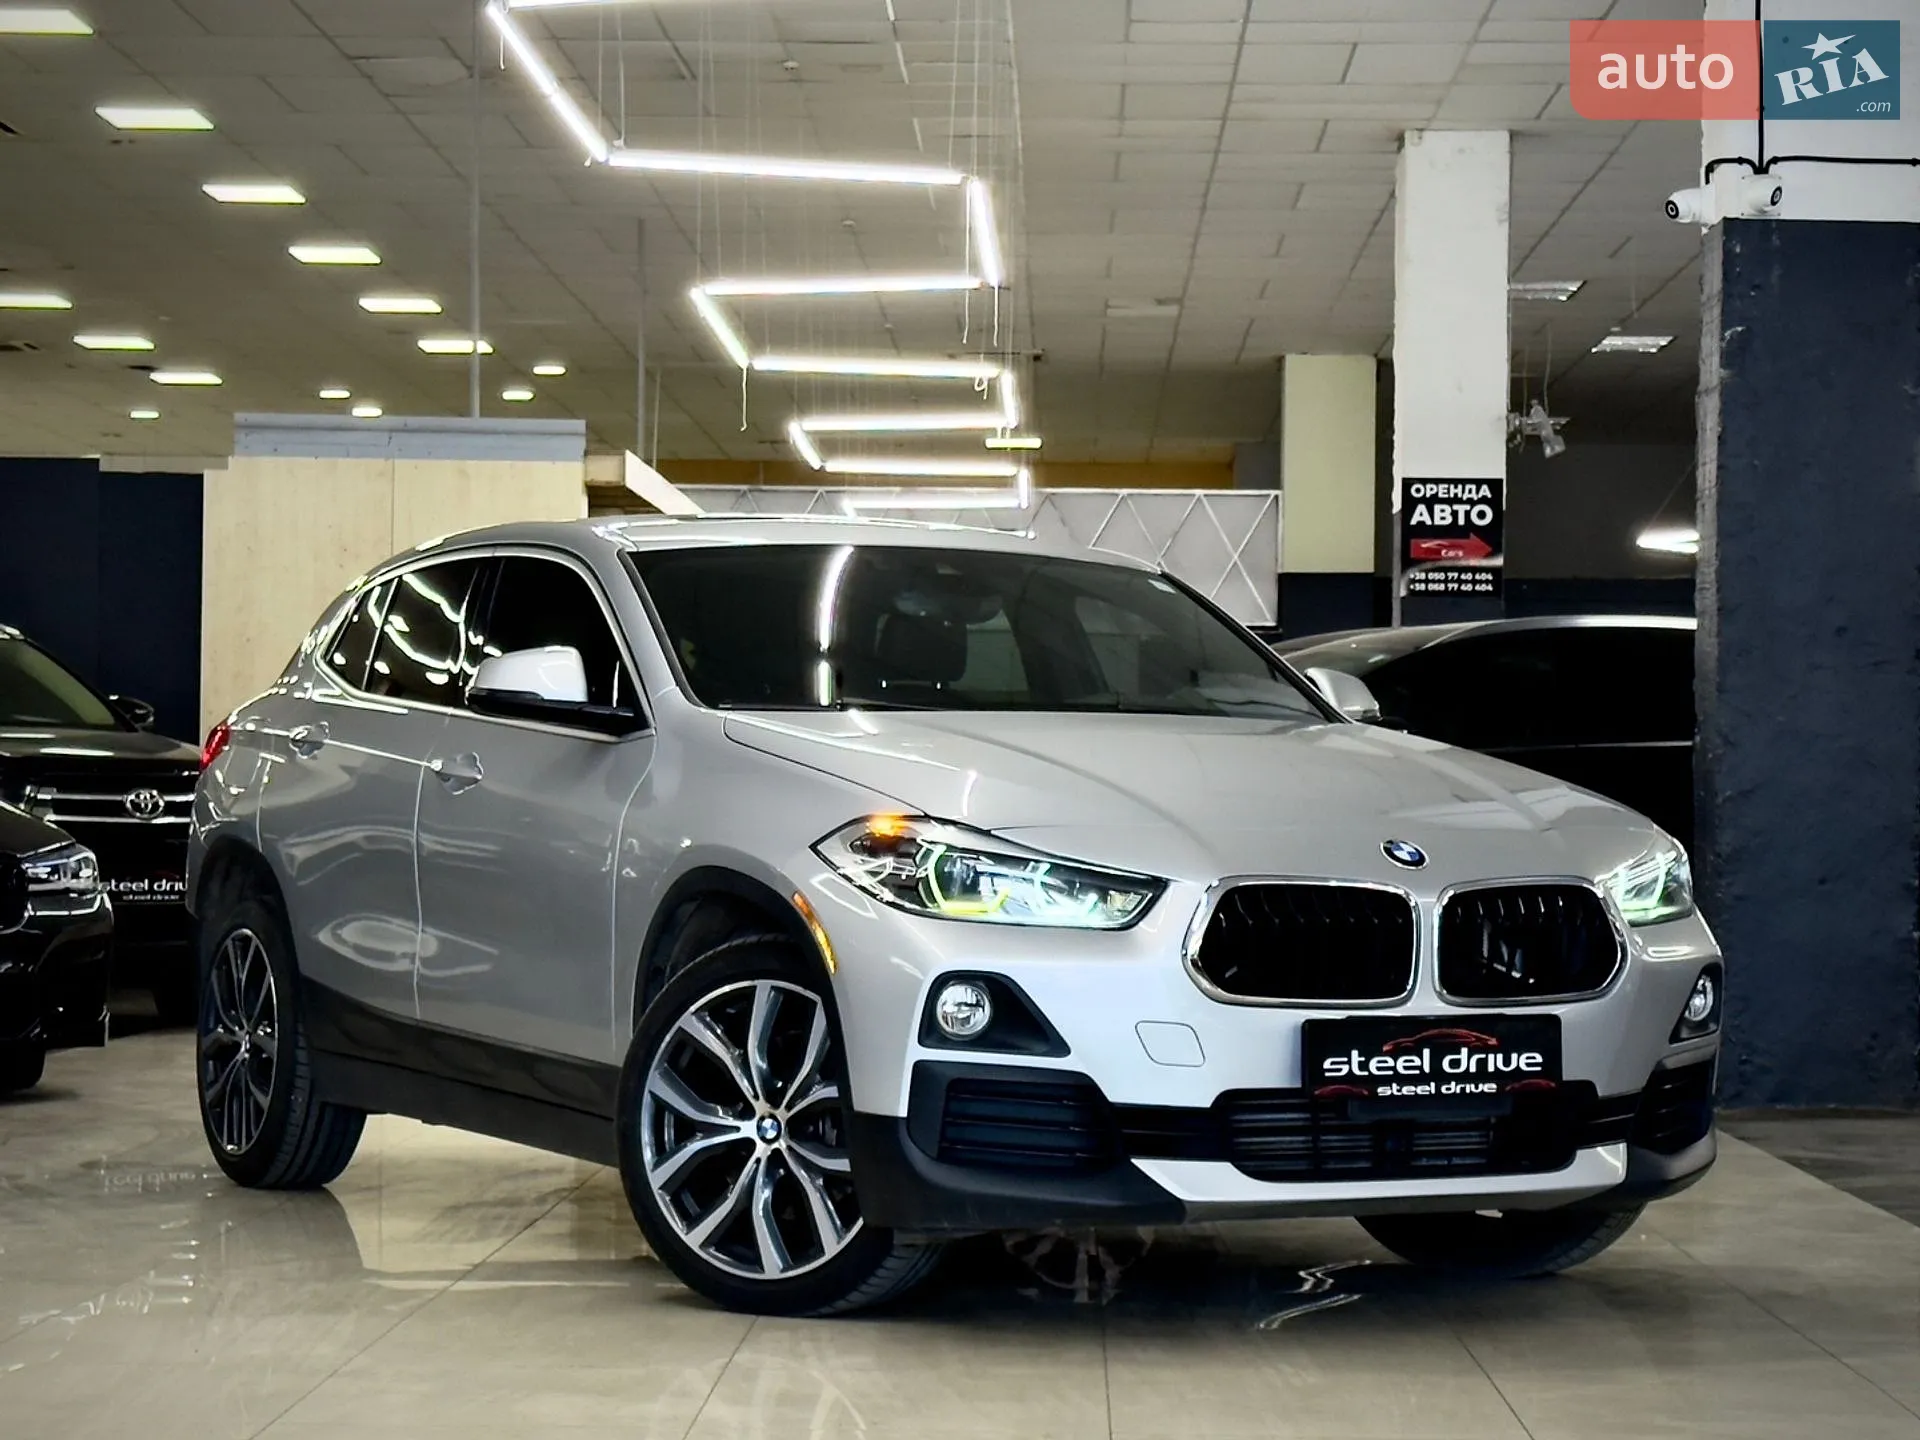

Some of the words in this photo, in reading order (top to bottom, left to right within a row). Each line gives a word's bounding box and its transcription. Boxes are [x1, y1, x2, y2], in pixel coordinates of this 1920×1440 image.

[1410, 483, 1492, 501] ОРЕНДА
[1409, 503, 1493, 526] АВТО
[1447, 572, 1459, 580] 77
[1447, 583, 1459, 591] 77
[153, 878, 188, 892] driv
[1323, 1048, 1430, 1077] steel
[1442, 1047, 1543, 1073] drive
[1377, 1082, 1436, 1096] steel
[1440, 1081, 1497, 1094] drive
